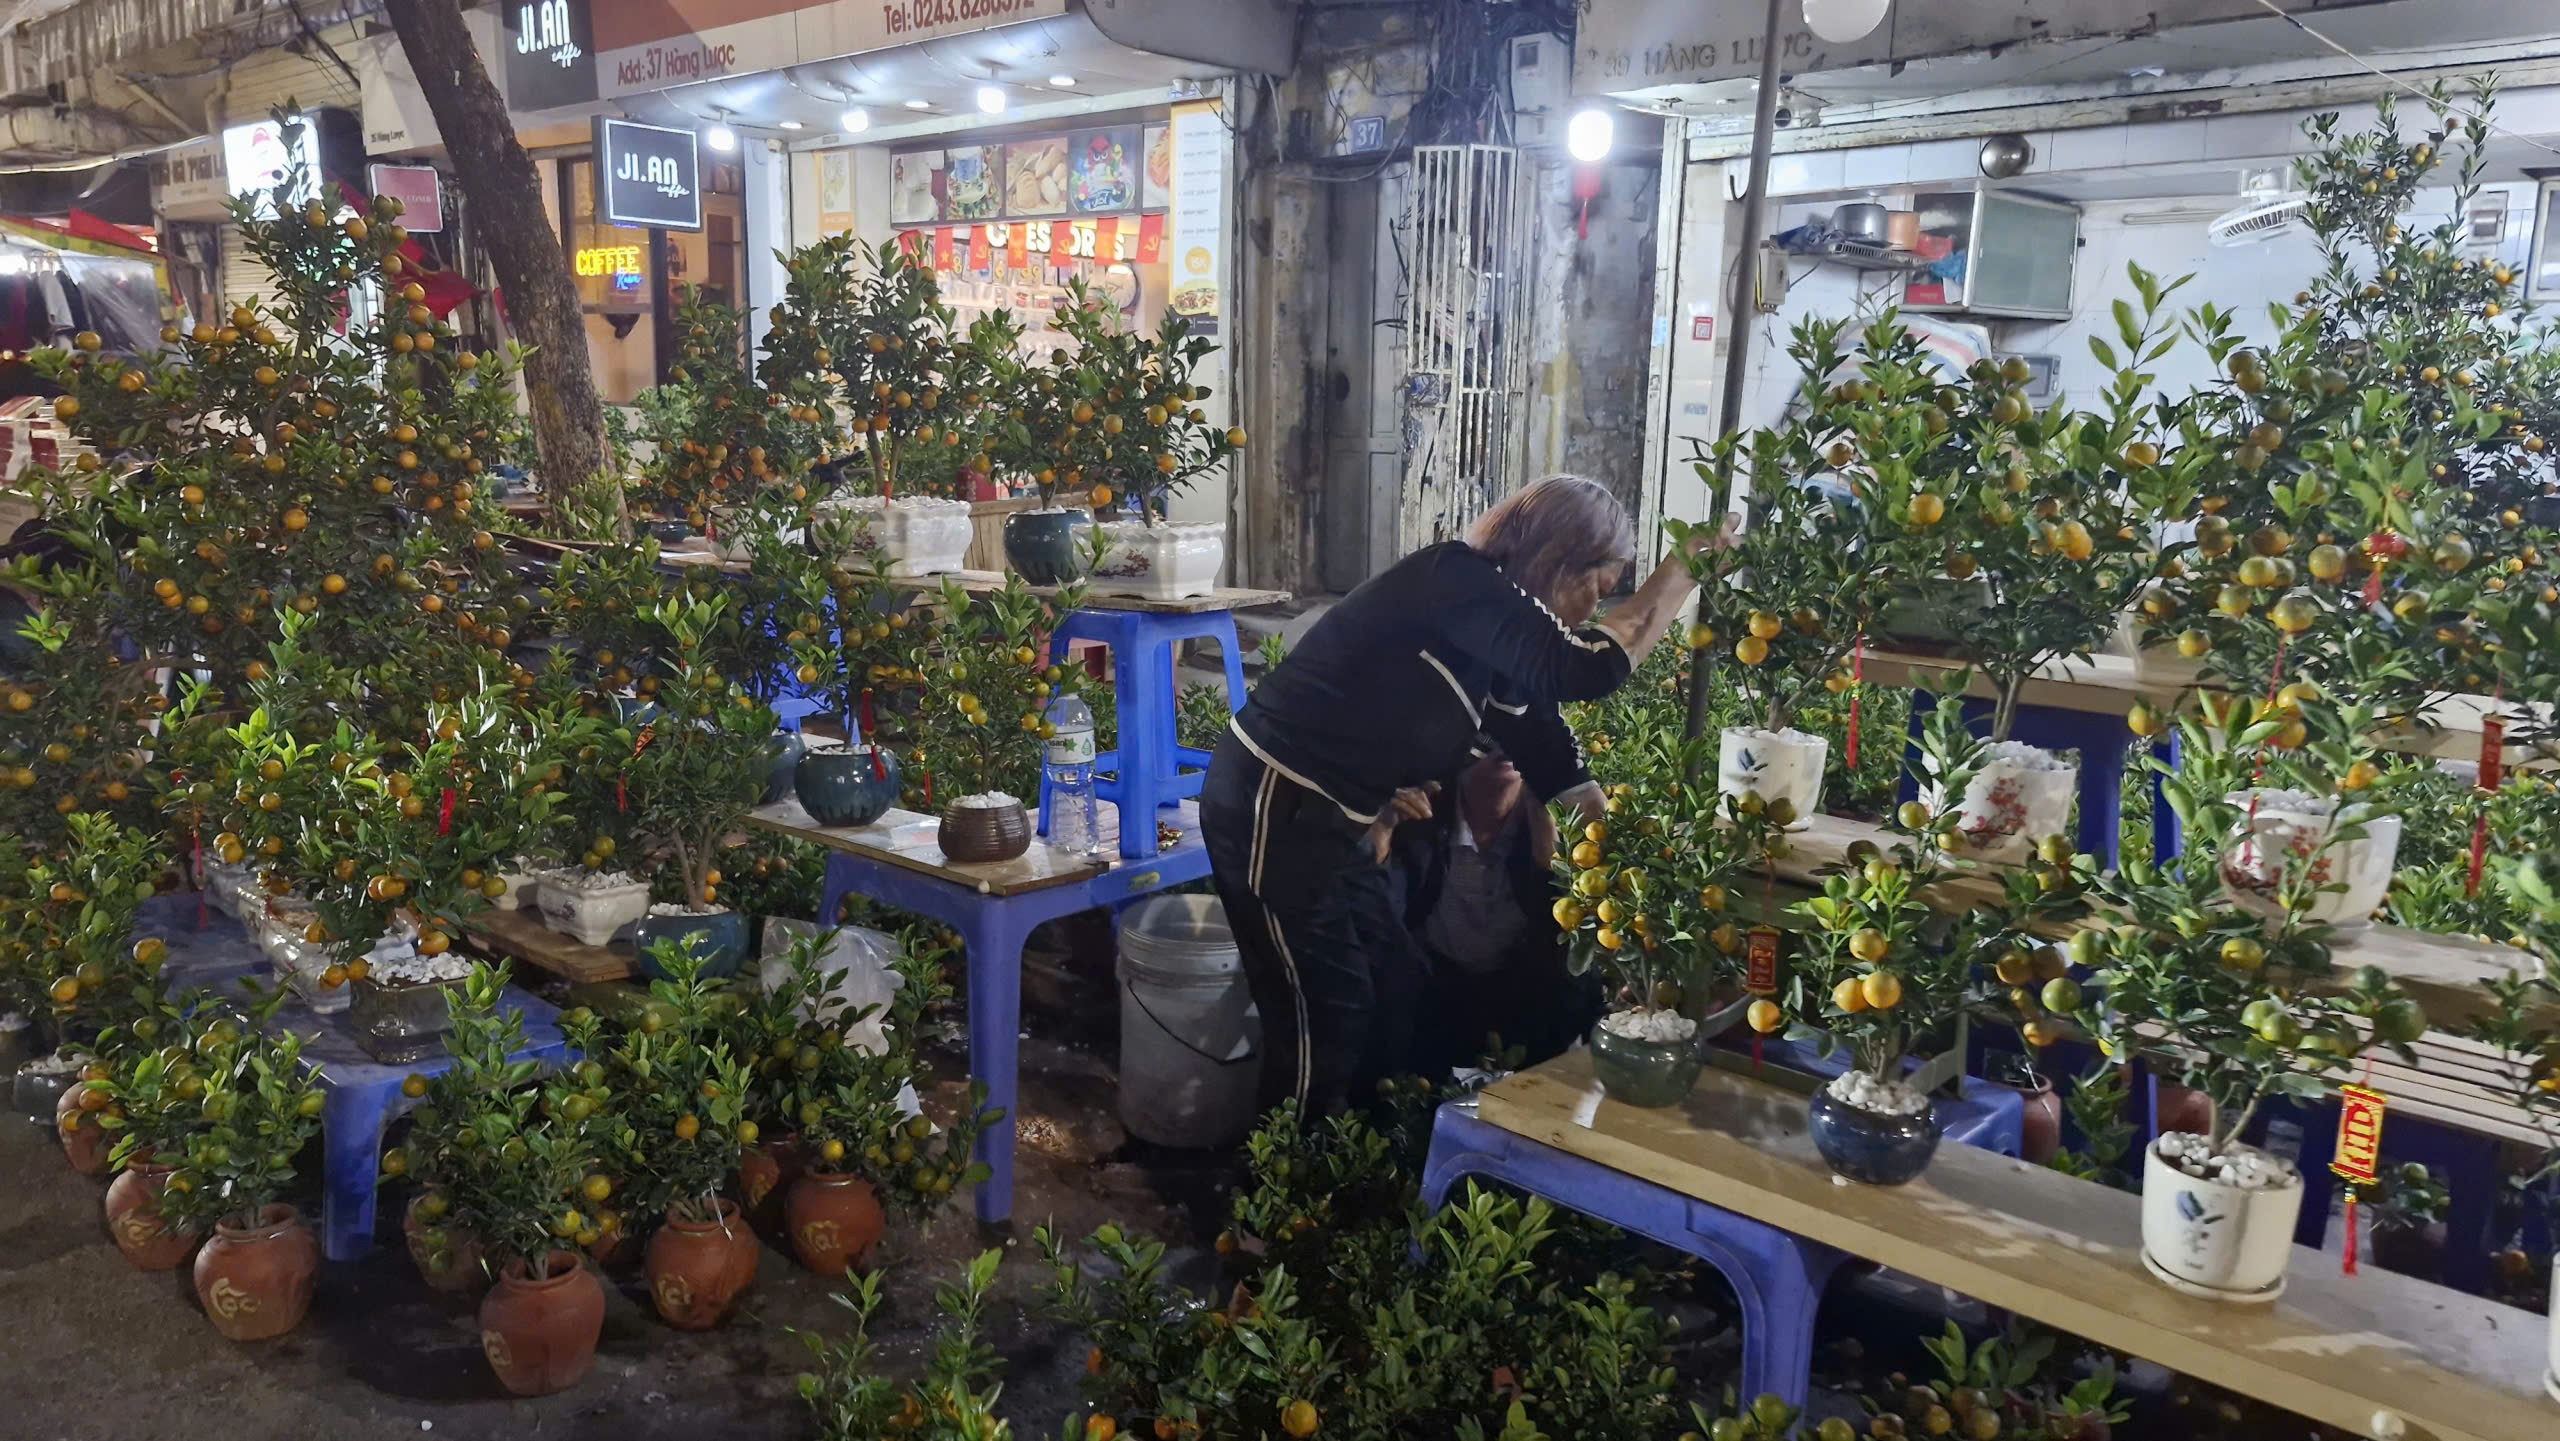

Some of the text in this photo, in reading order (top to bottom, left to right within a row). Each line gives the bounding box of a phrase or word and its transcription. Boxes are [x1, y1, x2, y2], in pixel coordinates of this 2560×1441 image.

[516, 0, 571, 55] JI.AN
[666, 49, 700, 79] Hàng
[1358, 121, 1378, 146] 37
[616, 152, 679, 186] JI.AN
[575, 245, 641, 276] COFFEE
